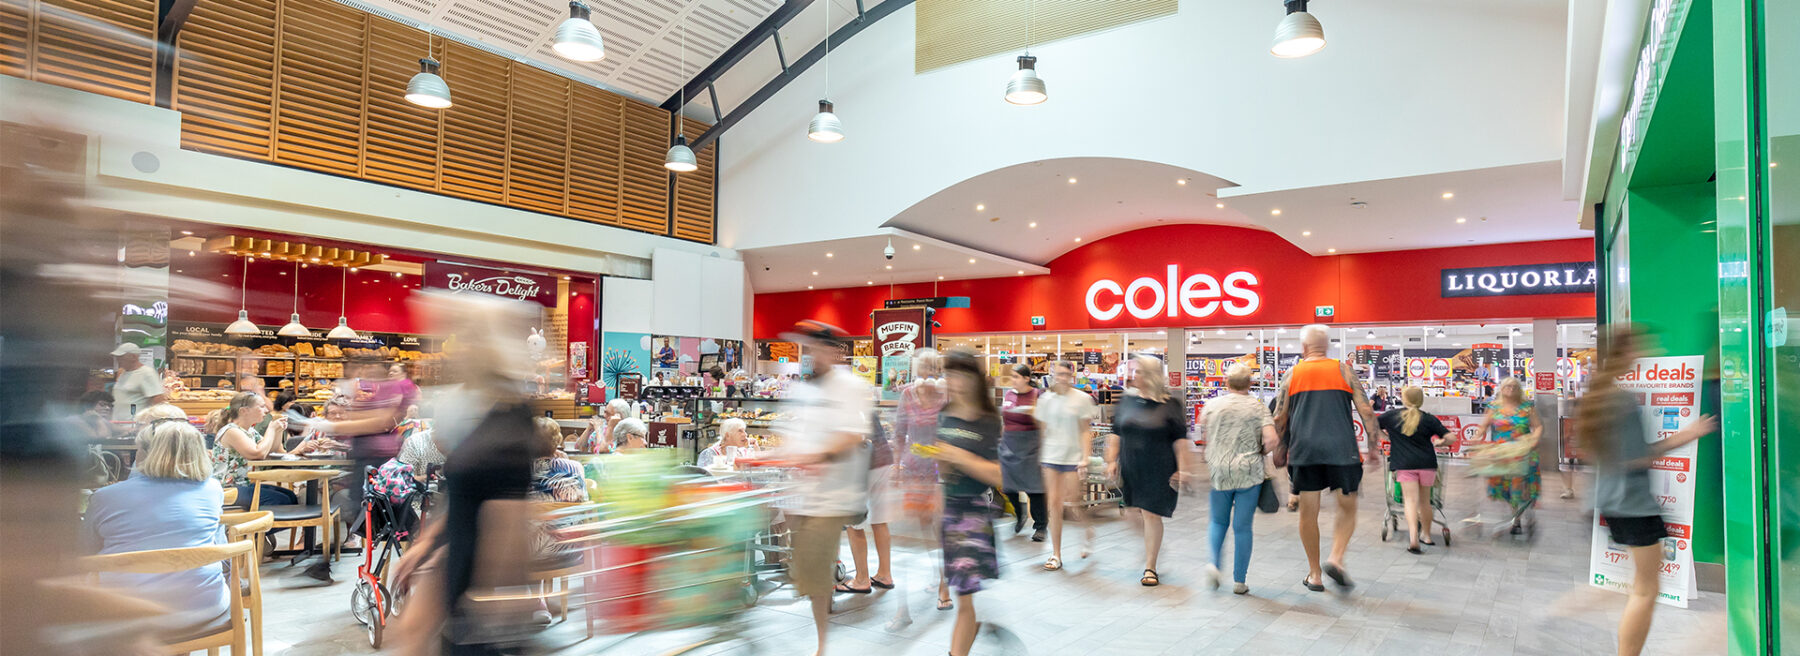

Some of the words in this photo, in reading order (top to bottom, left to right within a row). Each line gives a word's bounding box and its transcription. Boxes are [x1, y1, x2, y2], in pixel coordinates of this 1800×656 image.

[447, 273, 492, 291] Bakers
[495, 279, 540, 301] Delight
[1085, 264, 1260, 321] coles
[185, 326, 210, 334] LOCAL
[881, 323, 914, 334] MUFFIN
[884, 342, 911, 352] BREAK
[1646, 362, 1695, 381] deals
